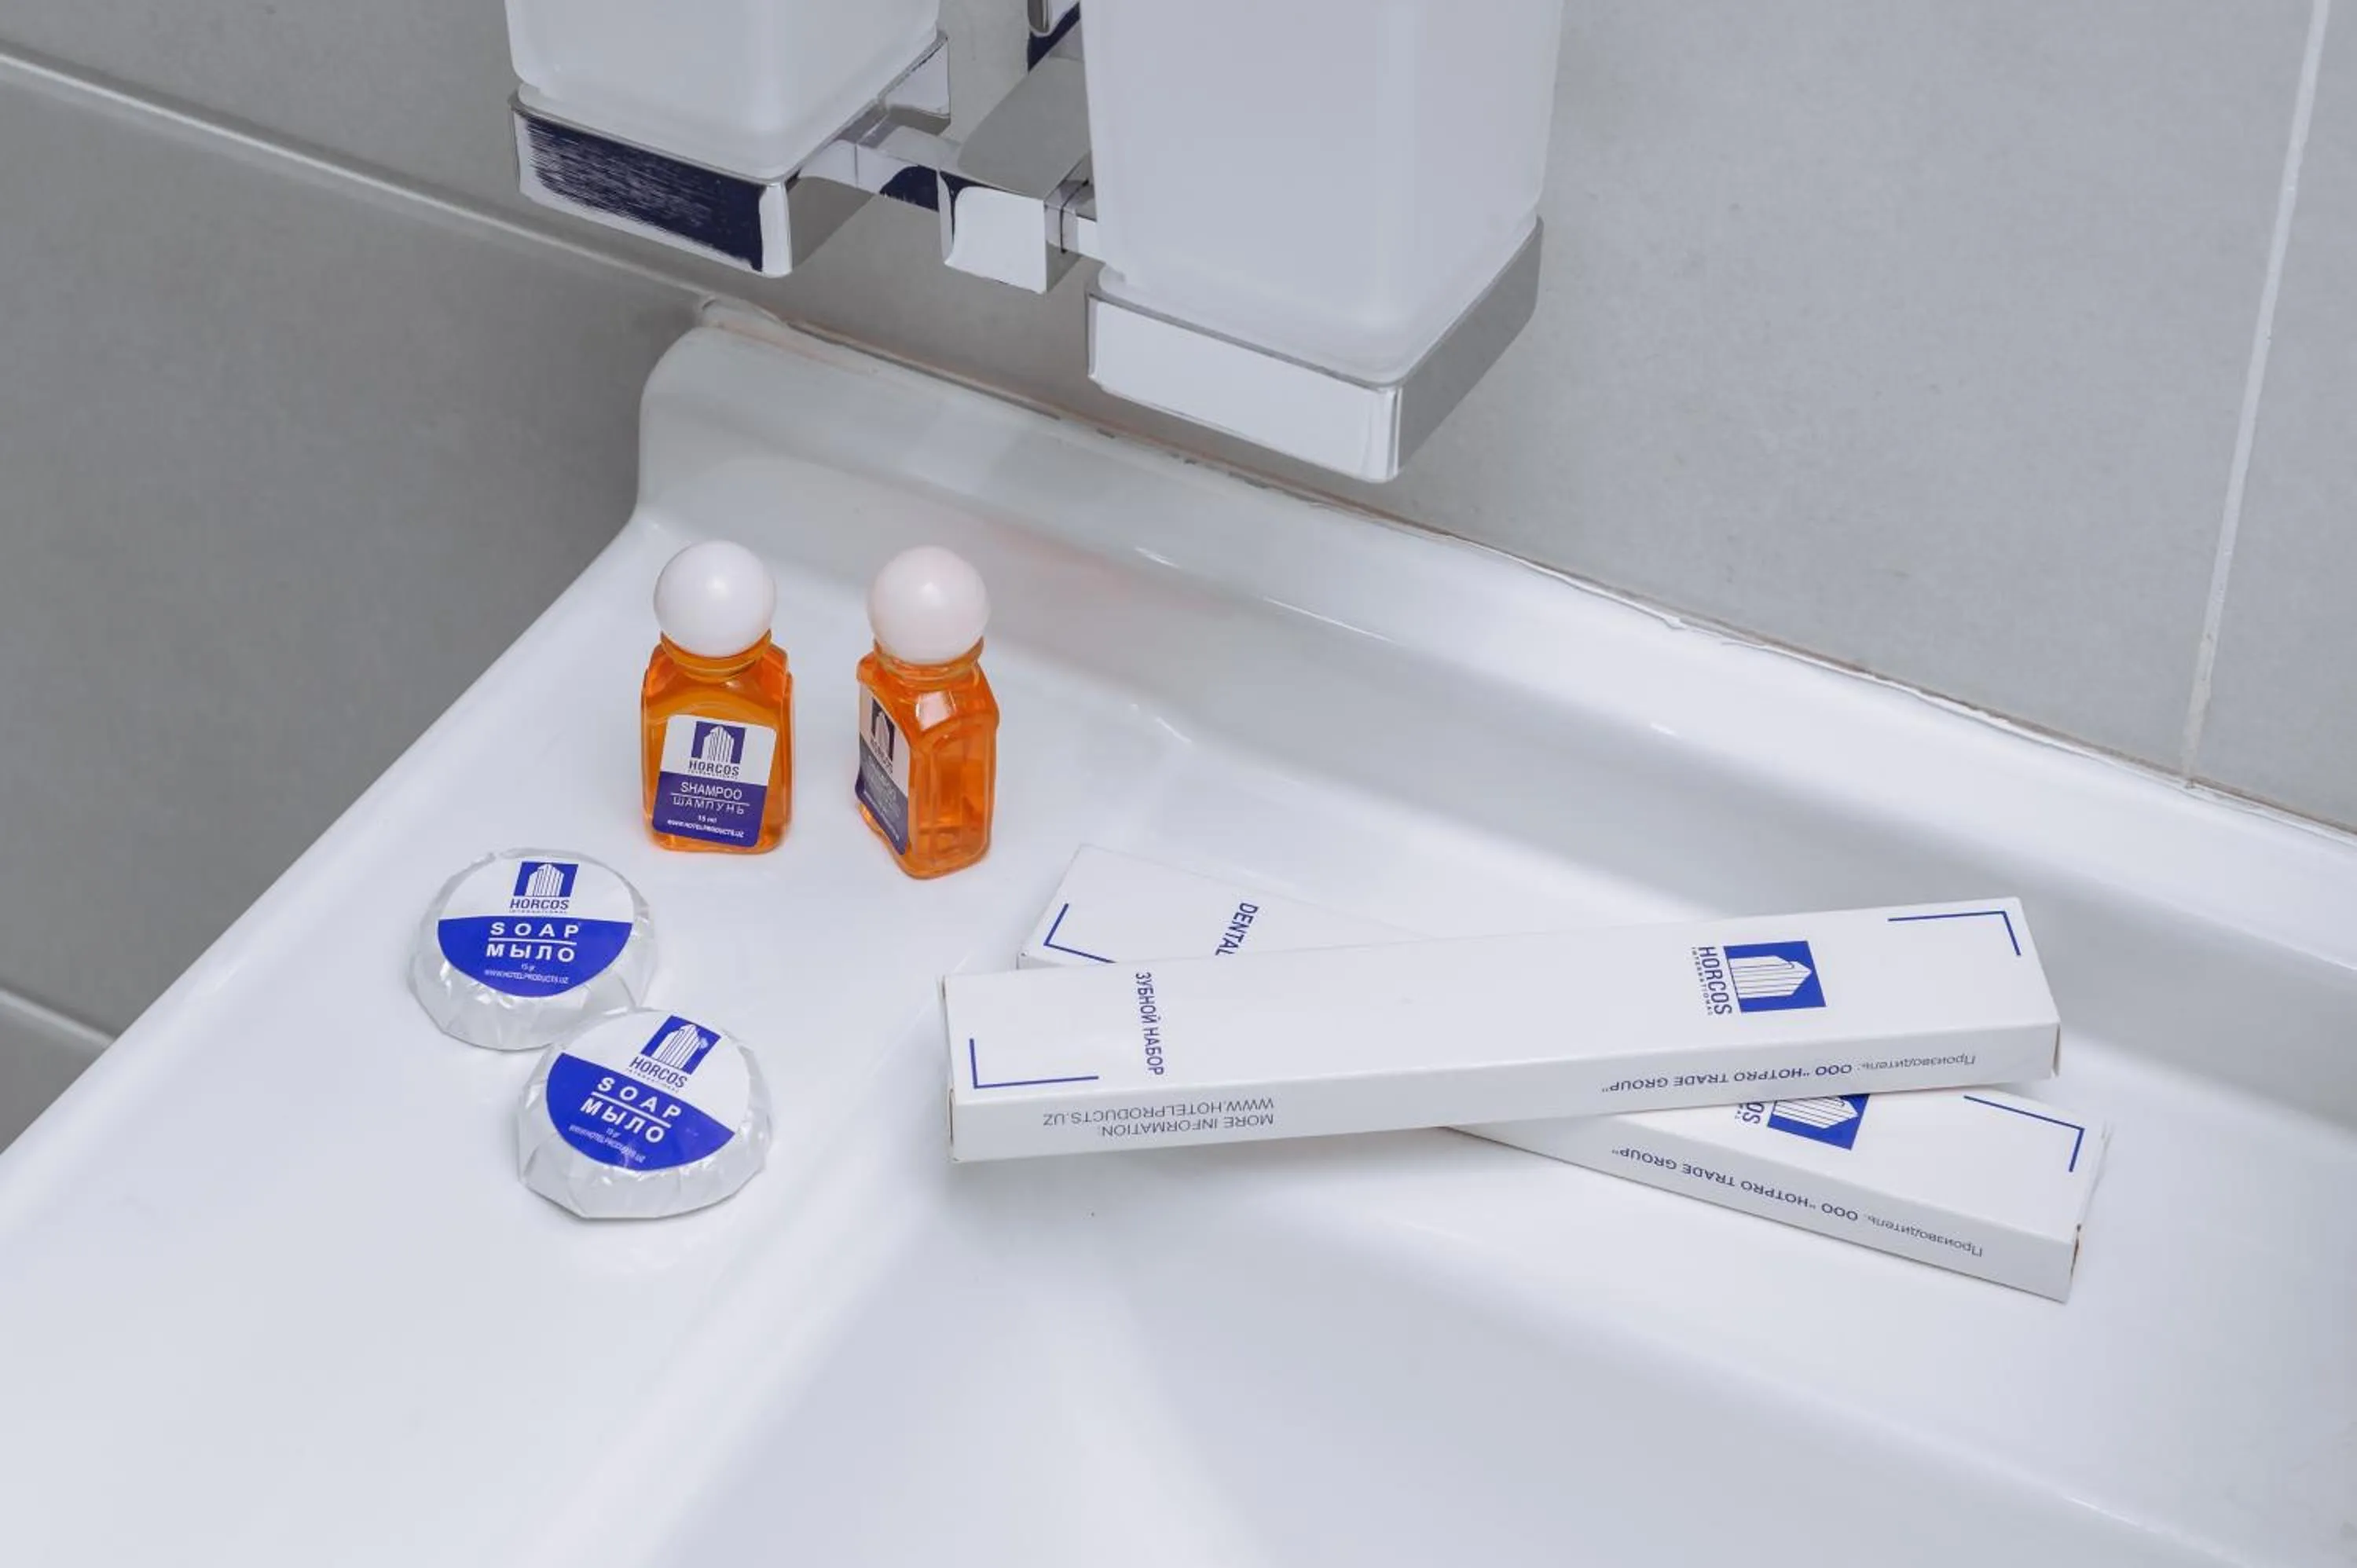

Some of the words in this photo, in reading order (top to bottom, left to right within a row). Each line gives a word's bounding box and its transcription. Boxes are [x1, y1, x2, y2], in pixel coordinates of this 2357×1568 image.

[688, 760, 740, 776] HORCOS
[680, 782, 742, 800] SHAMPOO
[673, 797, 745, 815] ШАМПУНЬ
[698, 815, 706, 823] 15
[509, 898, 570, 910] HORCOS
[489, 921, 579, 939] SOAP
[1215, 902, 1259, 956] DENTAL
[486, 943, 576, 963] МЫЛО
[1698, 946, 1732, 1015] HORCOS
[1135, 972, 1160, 1024] ЗУБНОЙ
[1142, 1027, 1164, 1075] НАБОР
[629, 1056, 687, 1089] HORCOS
[1673, 1072, 1729, 1087] TRADE
[597, 1076, 682, 1119] SOAP
[580, 1097, 665, 1143] МЫЛО
[1043, 1097, 1274, 1127] WWW.HOTELPRODUCTS.UZ
[1223, 1114, 1274, 1129] MORE
[1681, 1163, 1736, 1187] TRADE
